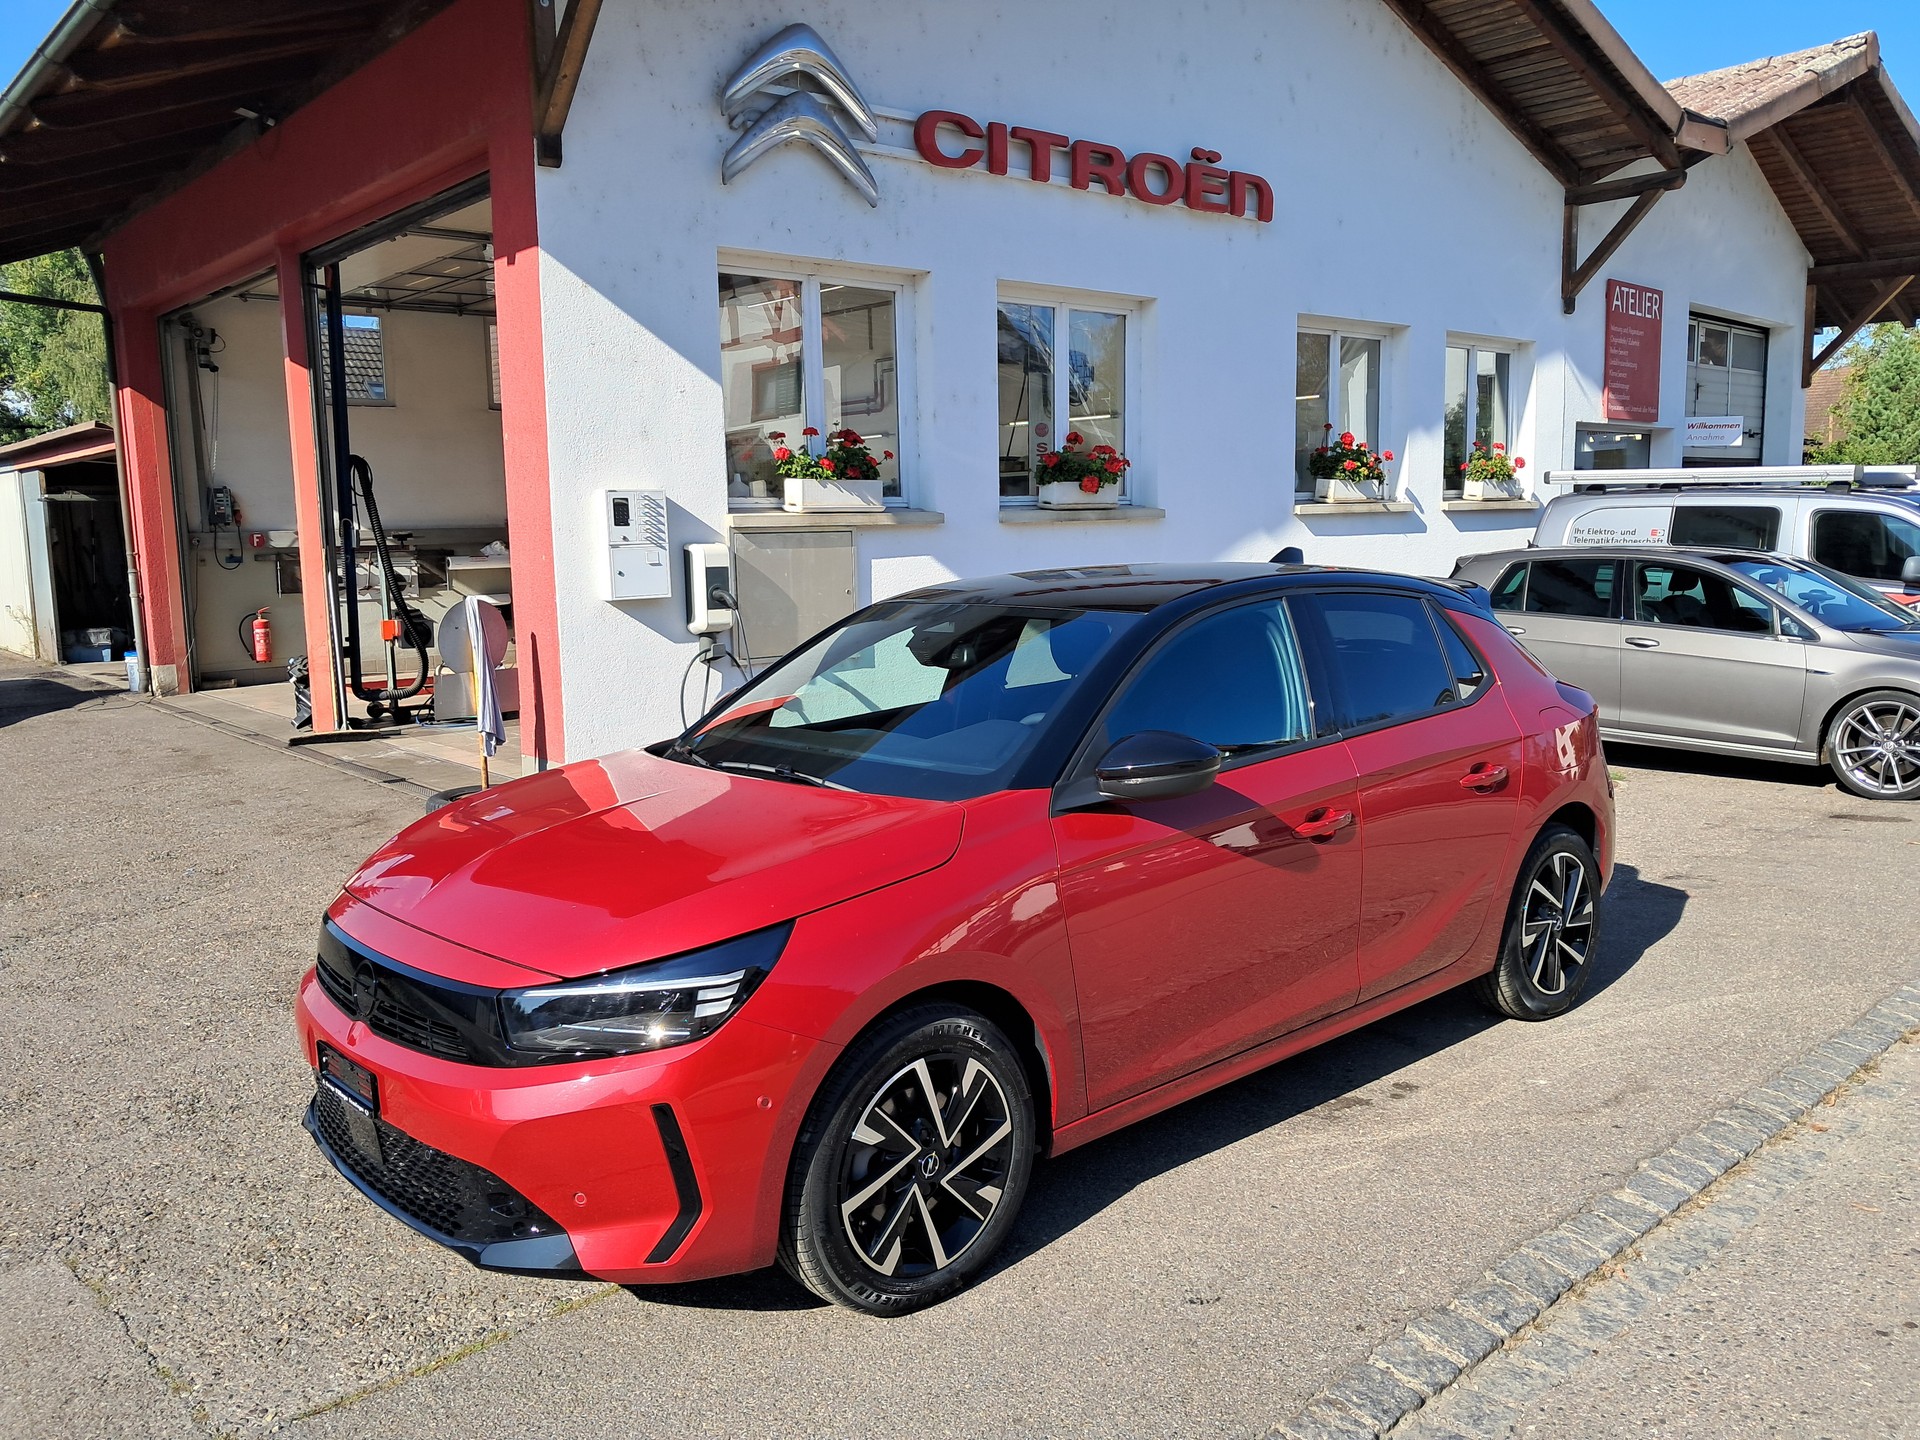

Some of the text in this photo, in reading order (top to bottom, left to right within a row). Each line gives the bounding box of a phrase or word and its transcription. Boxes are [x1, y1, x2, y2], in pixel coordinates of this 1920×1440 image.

[1612, 286, 1660, 320] ATELIER
[1687, 422, 1740, 430] Willkommen
[1686, 433, 1725, 441] Annahme
[1587, 528, 1618, 536] Elektro-
[253, 534, 261, 546] F
